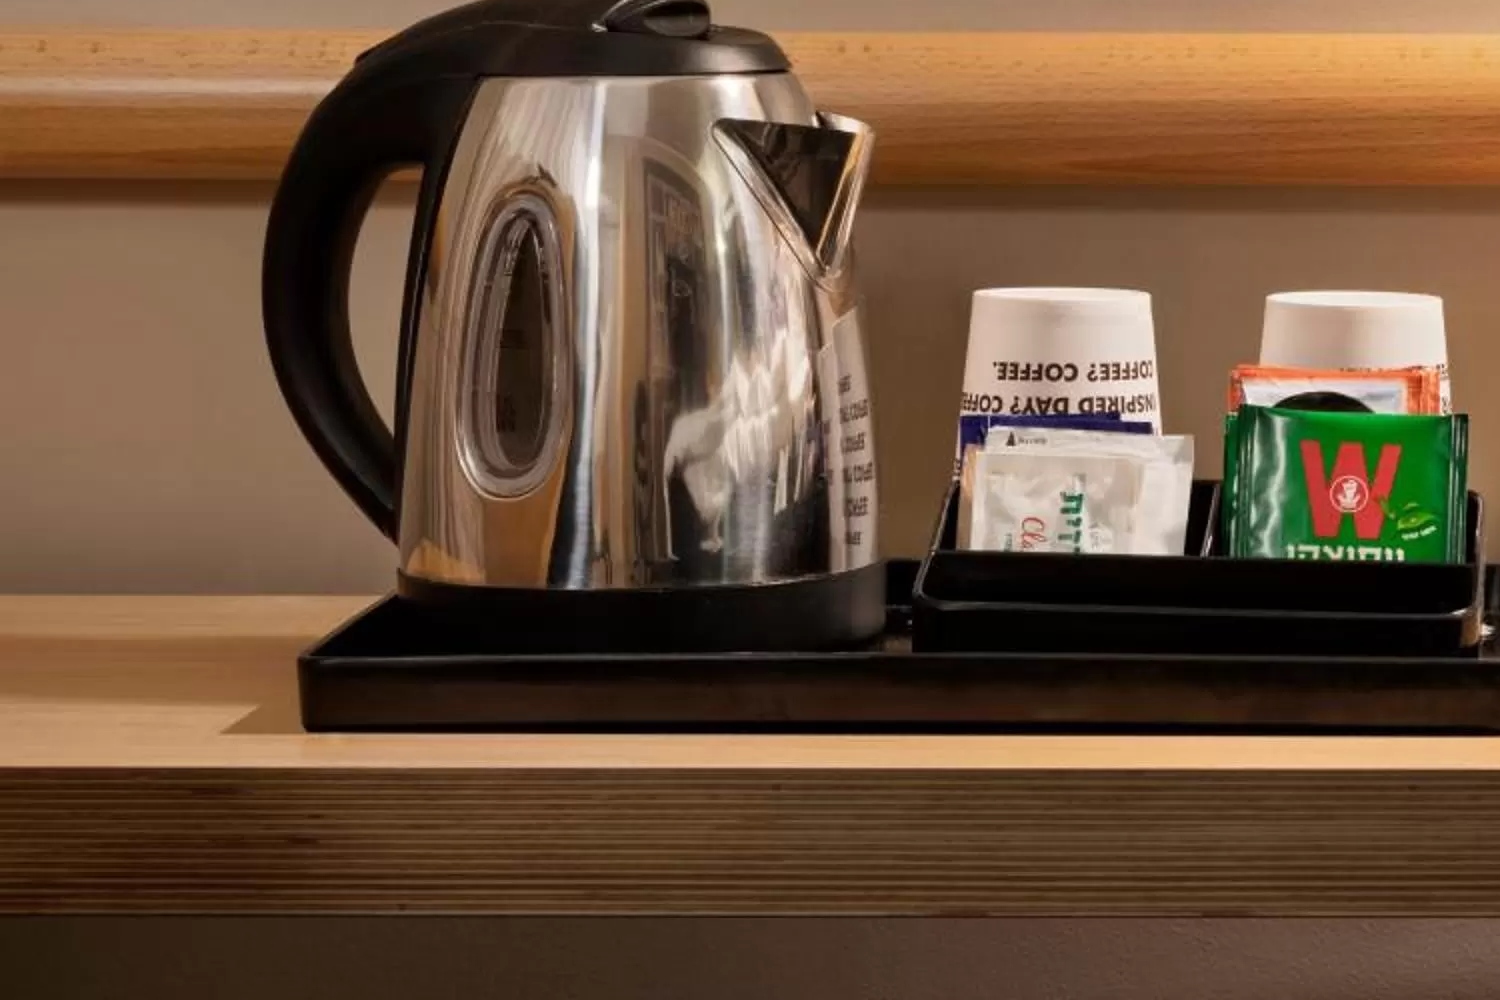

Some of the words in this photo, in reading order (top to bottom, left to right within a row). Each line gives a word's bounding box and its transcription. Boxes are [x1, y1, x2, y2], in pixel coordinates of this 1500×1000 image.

[992, 360, 1079, 383] COFFEE.
[1009, 394, 1070, 415] DAY?
[1300, 439, 1402, 539] W
